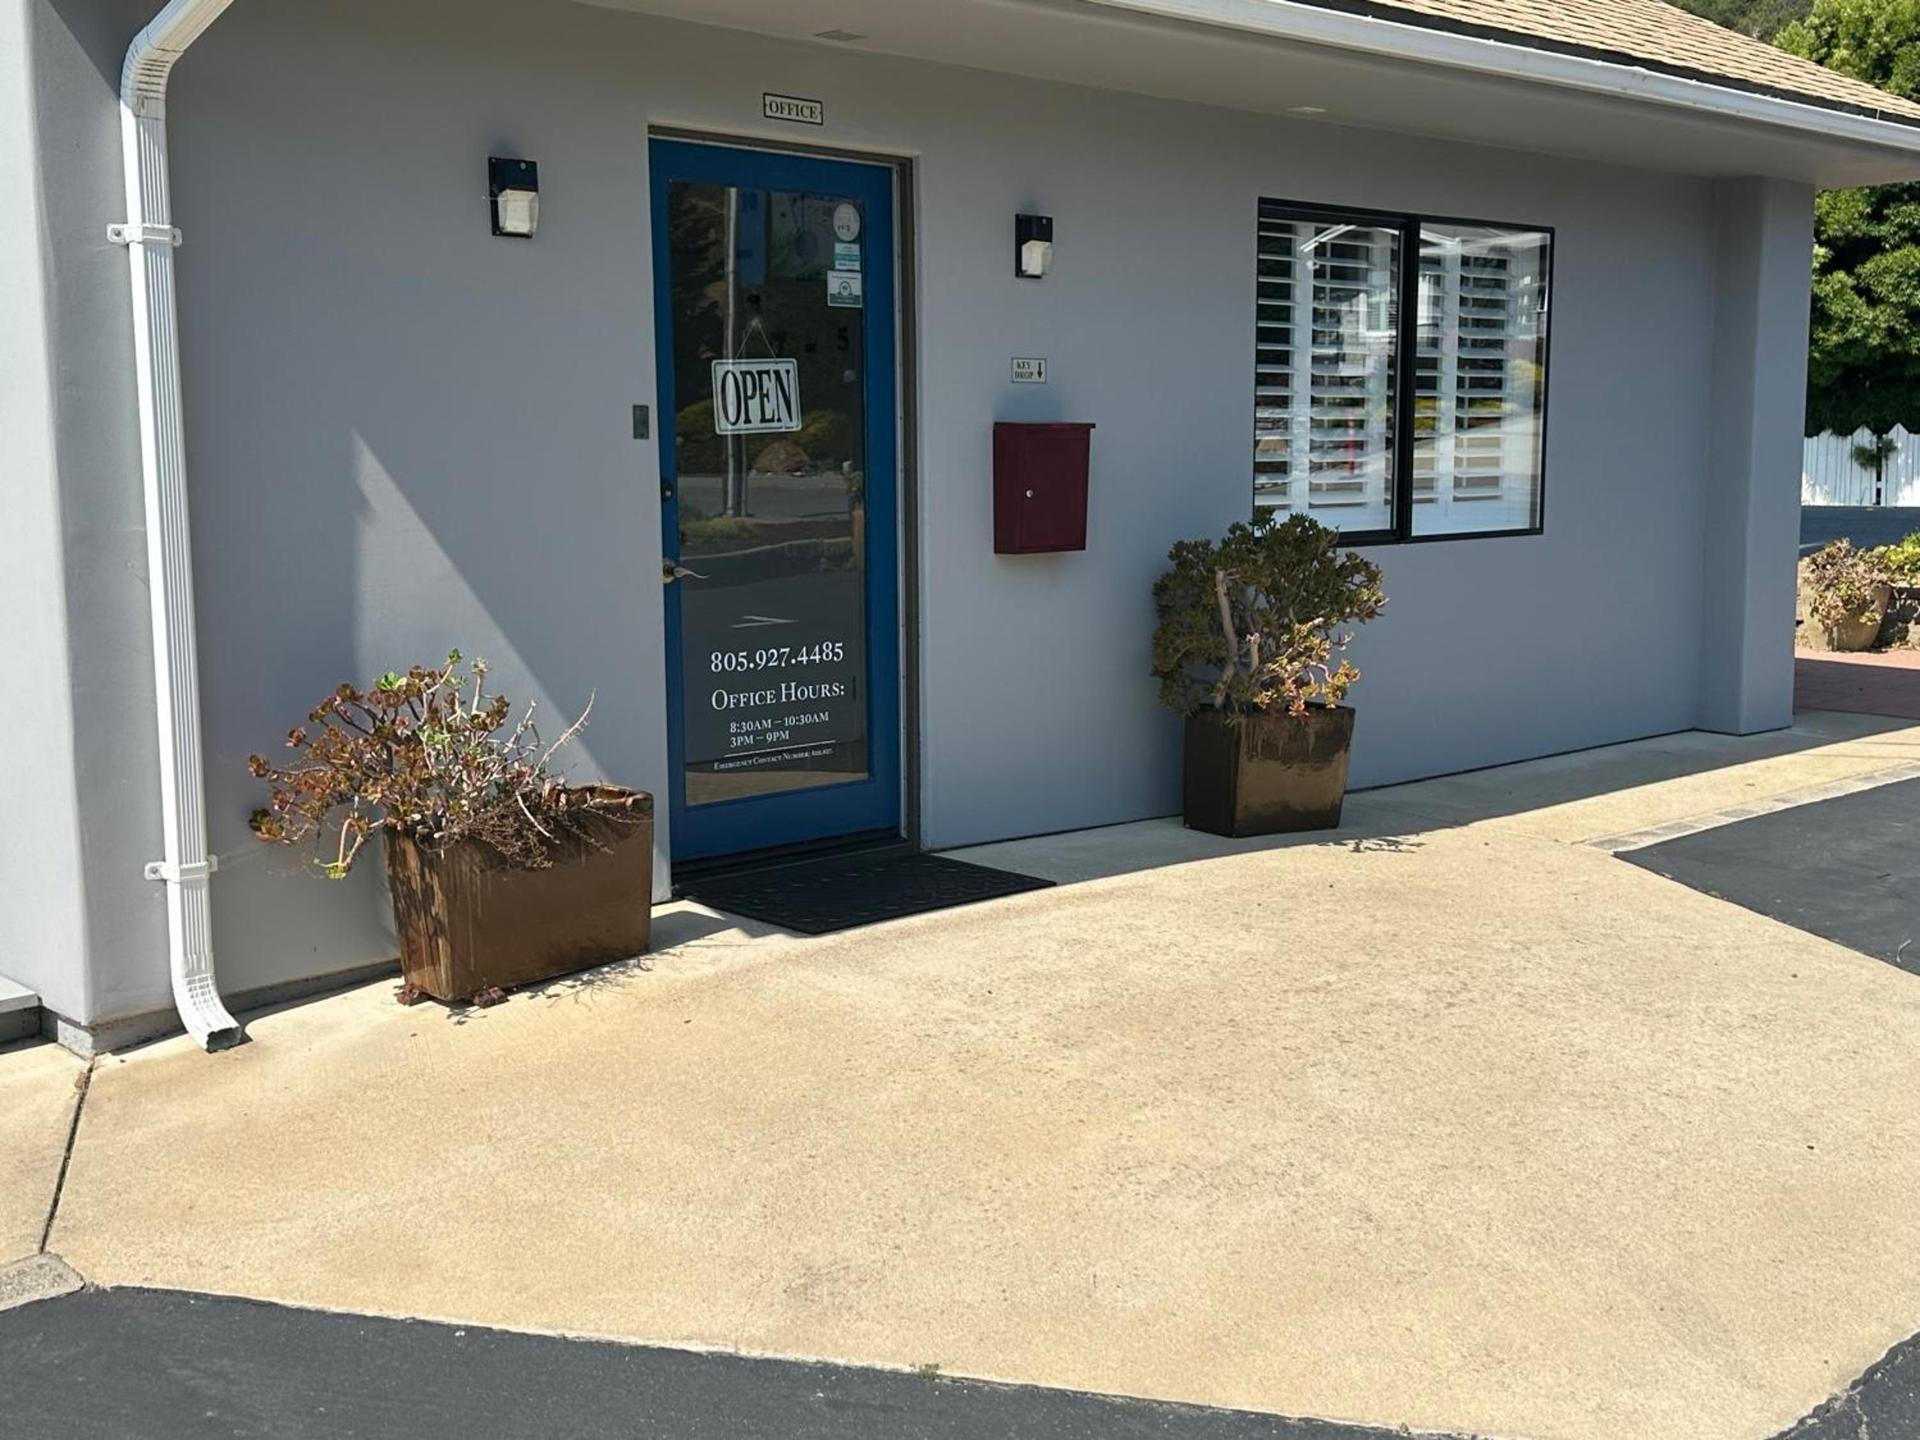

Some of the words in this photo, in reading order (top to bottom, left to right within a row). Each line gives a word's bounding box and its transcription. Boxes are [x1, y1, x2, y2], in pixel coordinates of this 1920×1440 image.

[769, 100, 818, 119] OFFICE
[720, 369, 793, 426] OPEN
[711, 641, 843, 673] 805.927.4485
[730, 719, 772, 734] 8:30AM
[784, 711, 829, 727] 10:30AM
[730, 735, 754, 748] 3PM
[766, 730, 790, 744] 9PM
